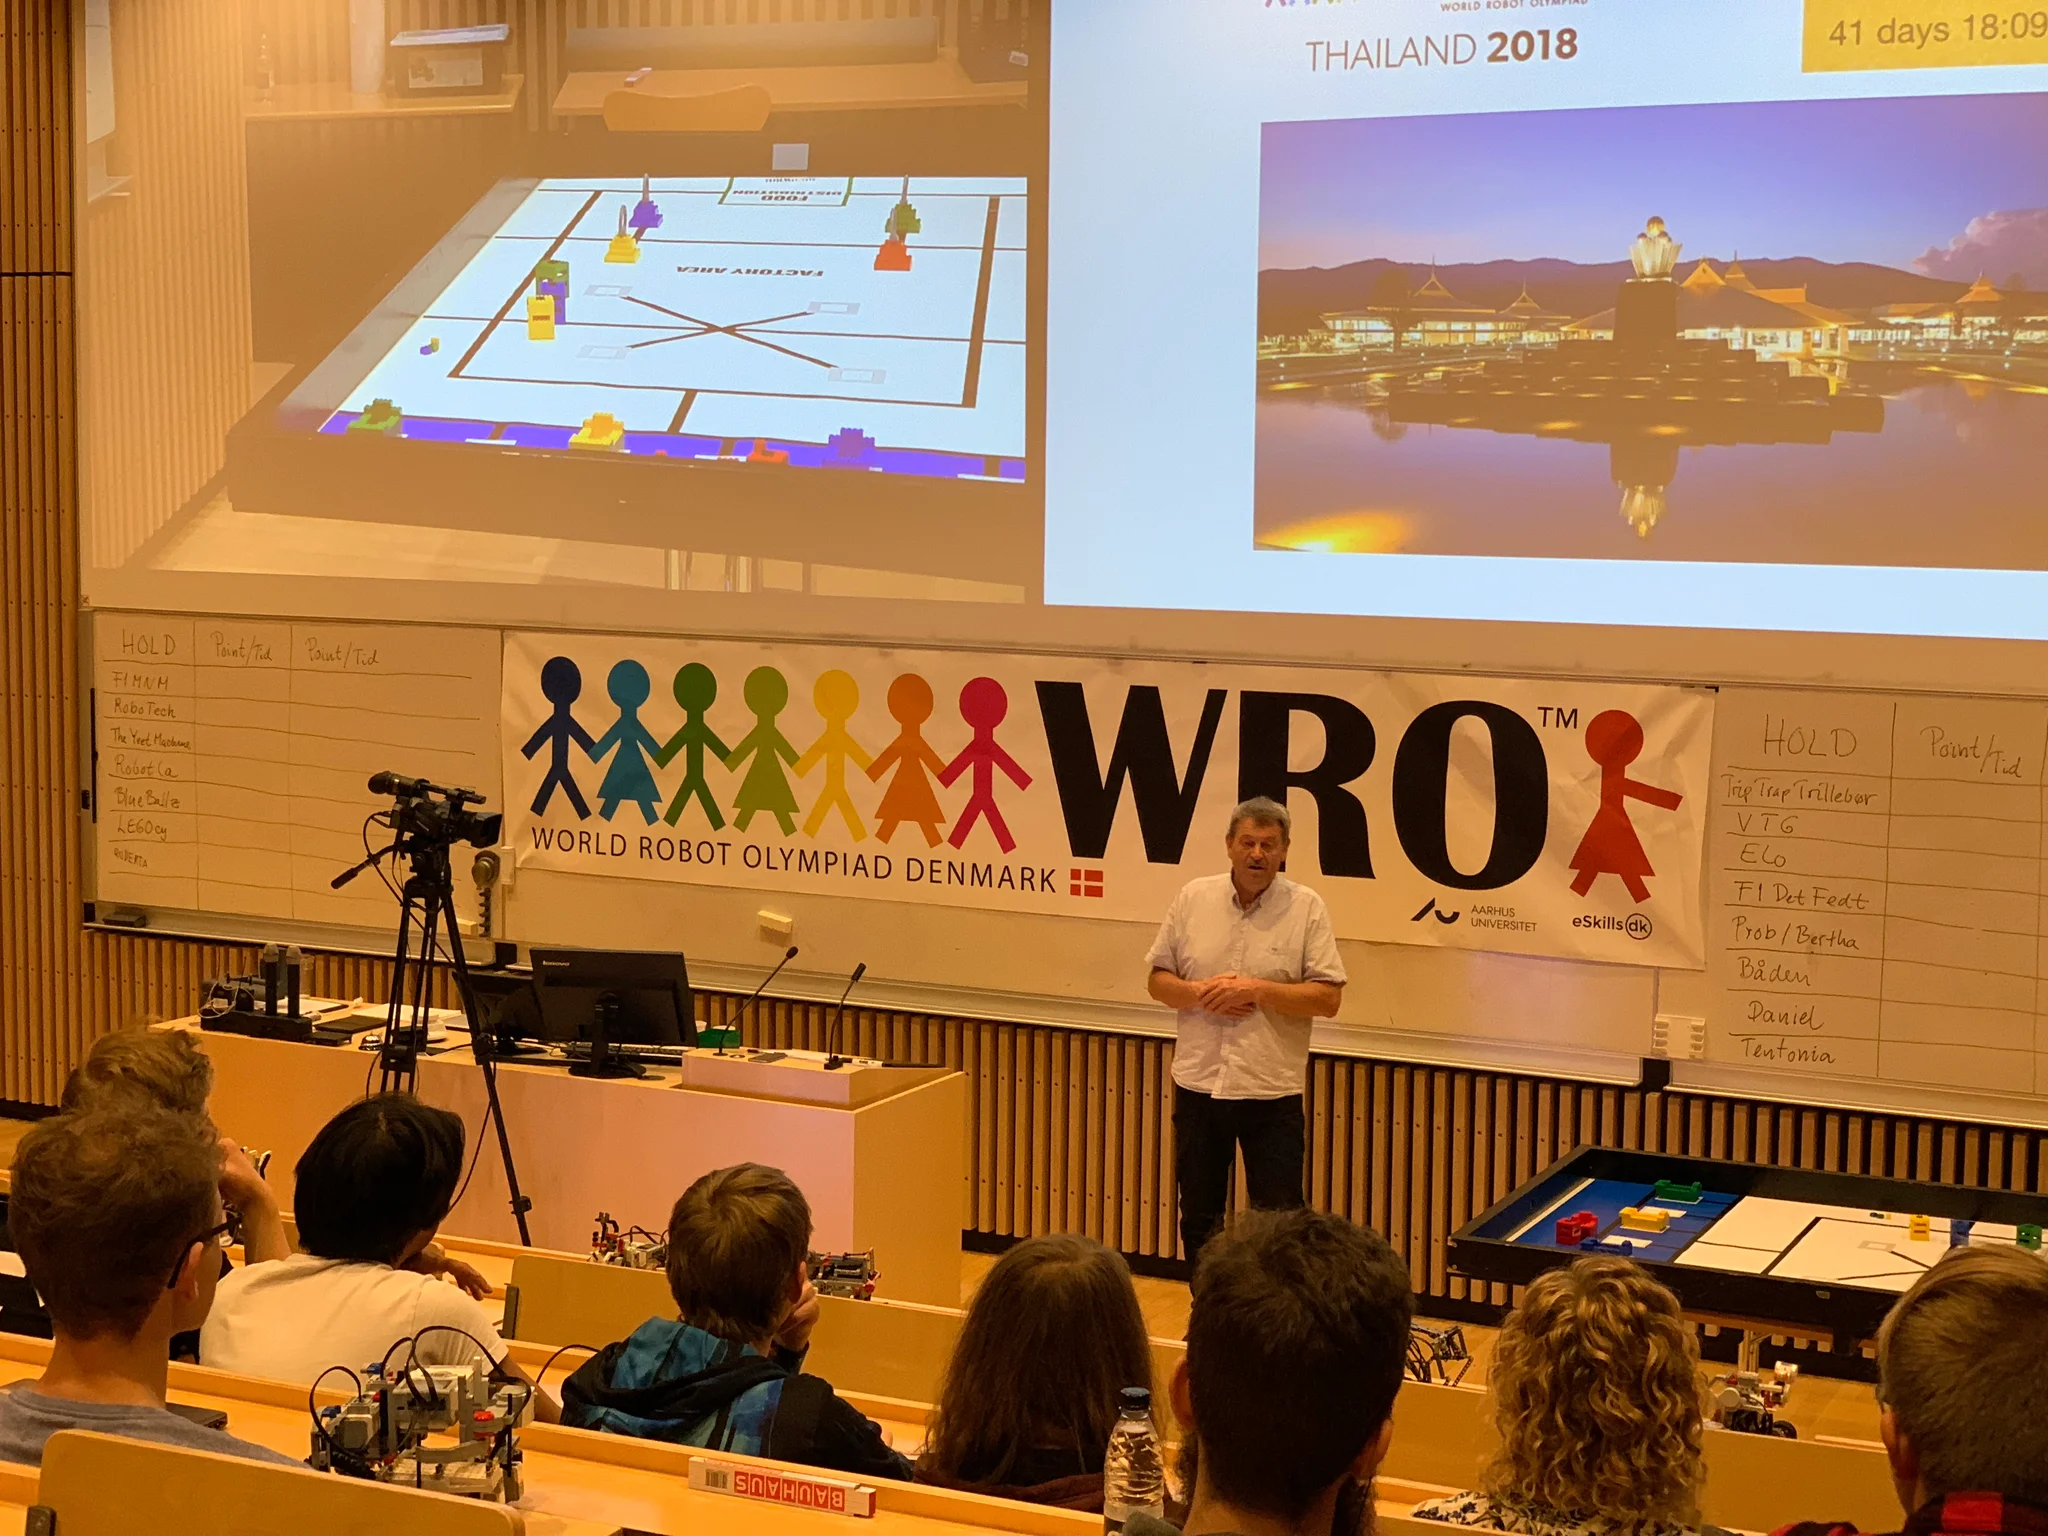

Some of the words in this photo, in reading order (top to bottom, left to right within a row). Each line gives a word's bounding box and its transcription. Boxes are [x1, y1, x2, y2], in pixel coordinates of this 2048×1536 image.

[1829, 20, 1862, 46] 41
[1877, 17, 1950, 50] days
[1963, 11, 2048, 41] 18:09
[1305, 33, 1477, 71] THAILAND
[1486, 27, 1578, 63] 2018
[122, 628, 176, 655] HOLD
[1763, 713, 1857, 757] HOLD
[1034, 680, 1548, 890] WRO
[1754, 777, 1791, 803] Trap
[532, 827, 627, 857] WORLD
[640, 836, 731, 866] ROBOT
[743, 845, 892, 879] OLYMPIAD
[906, 857, 1056, 893] DENMARK
[1471, 904, 1515, 917] AARHUS
[1471, 918, 1537, 932] UNIVERSITET
[1747, 1000, 1824, 1031] Daniel
[735, 1474, 843, 1508] BAUHAUS
